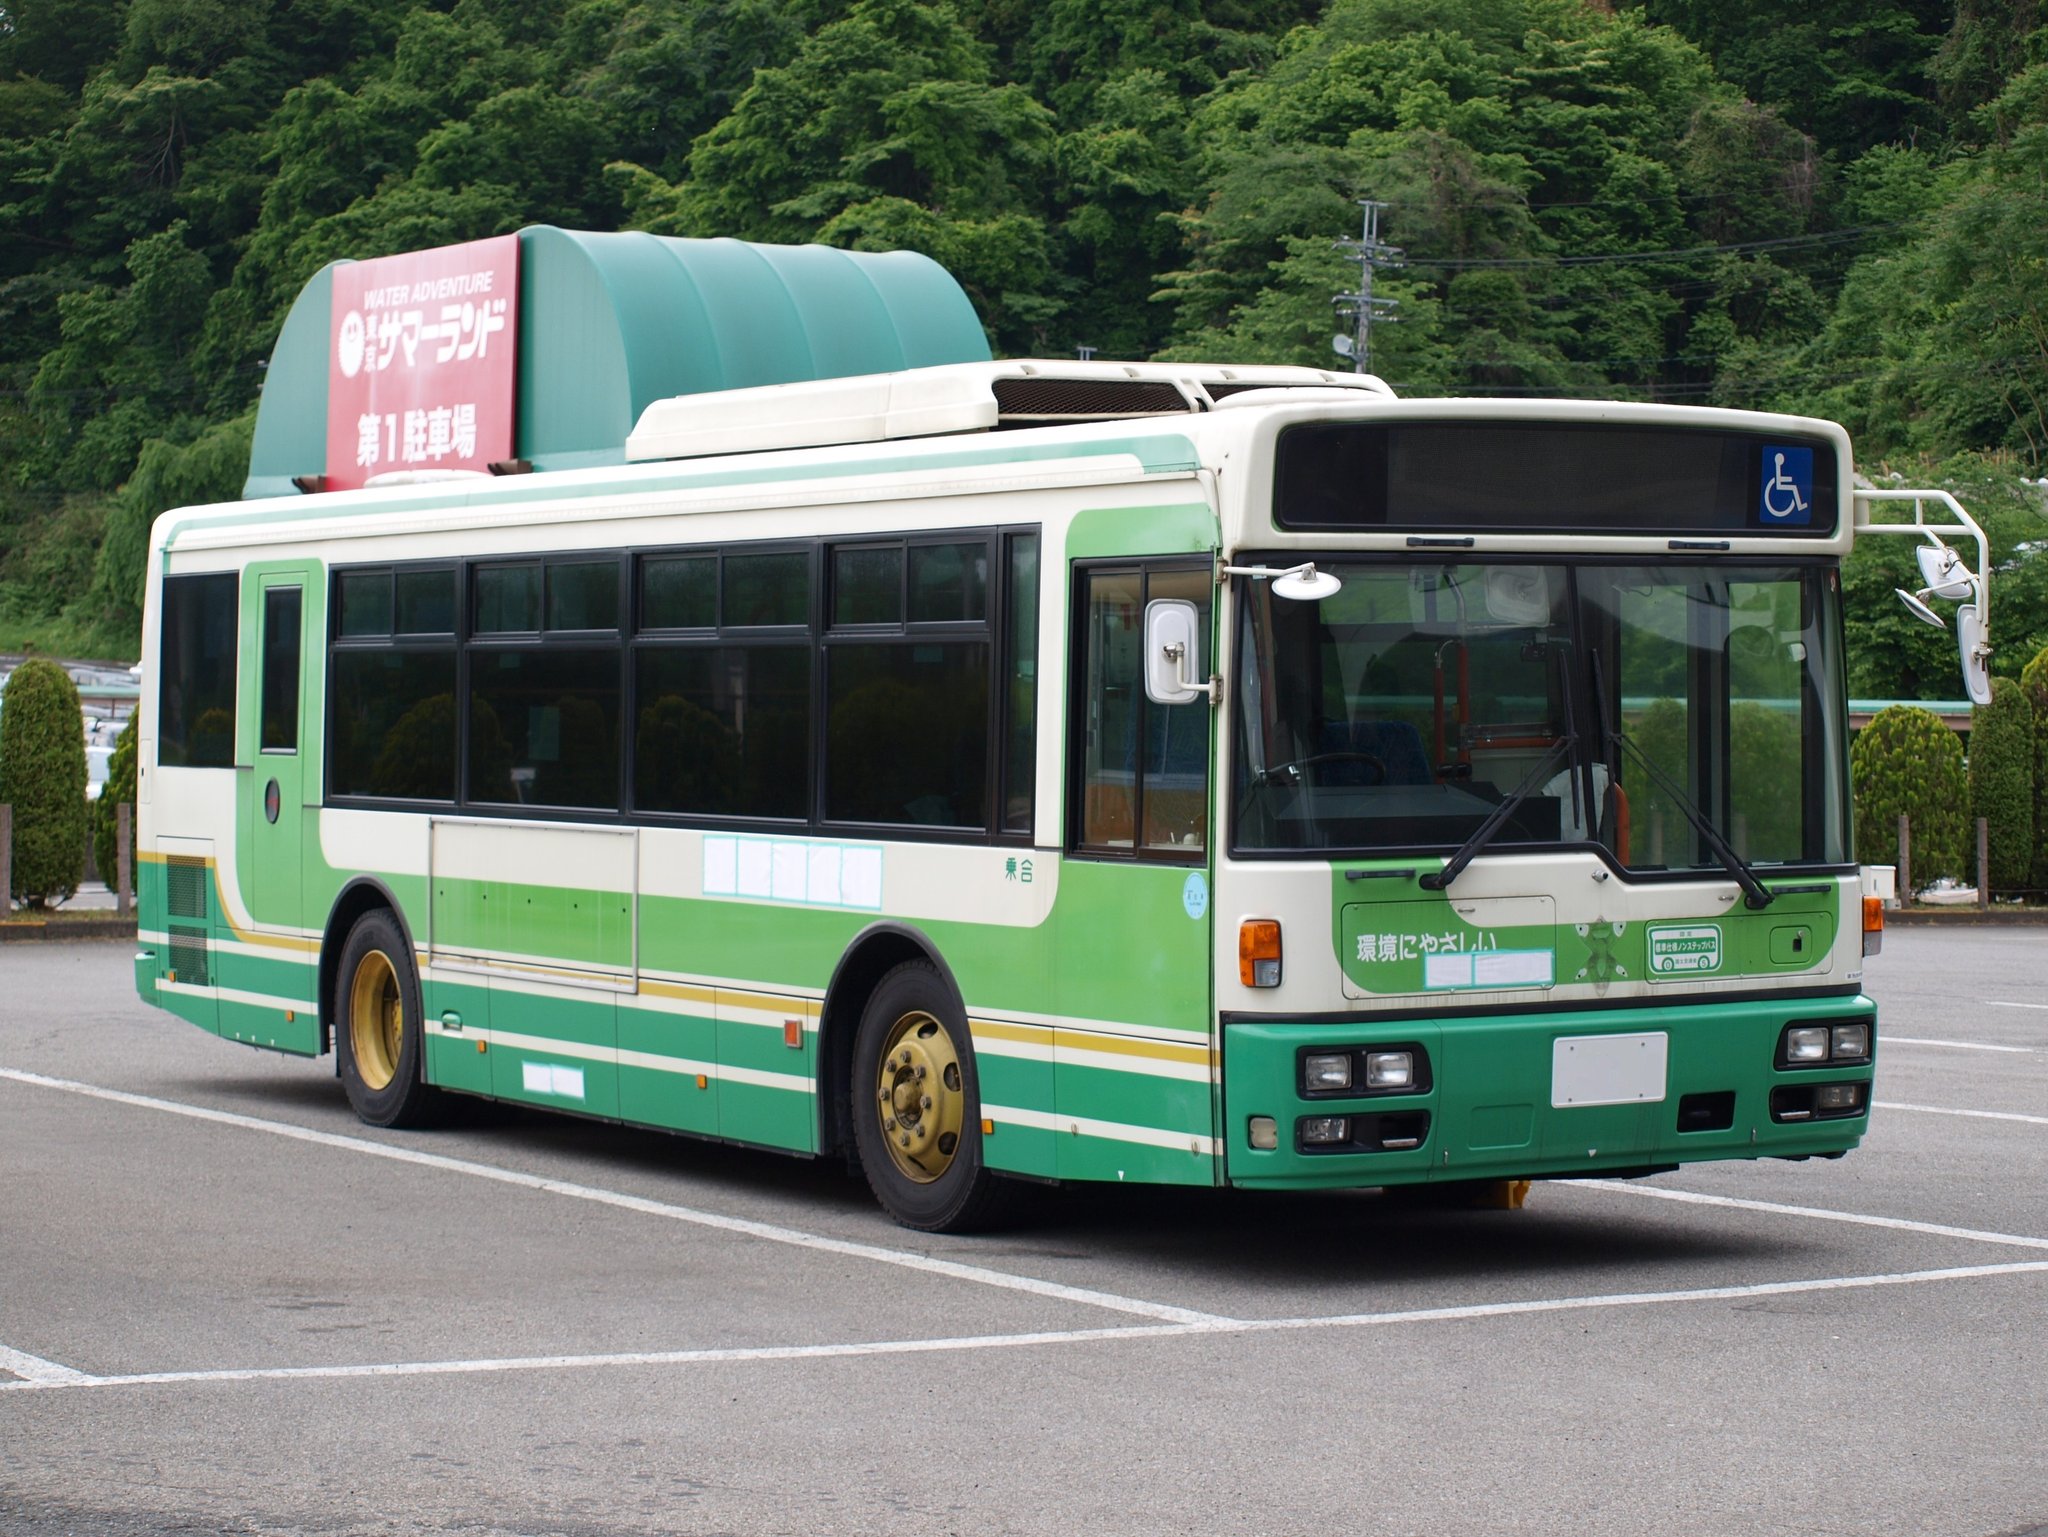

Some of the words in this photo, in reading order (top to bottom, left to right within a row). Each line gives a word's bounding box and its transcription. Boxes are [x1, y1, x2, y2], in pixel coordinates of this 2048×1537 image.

[364, 284, 410, 310] WATER
[410, 270, 495, 303] ADVENTURE
[377, 297, 507, 371] サマーランド
[356, 403, 476, 467] 第1駐車場
[1005, 857, 1033, 882] 乗合
[1356, 931, 1497, 962] 環境にやさしい
